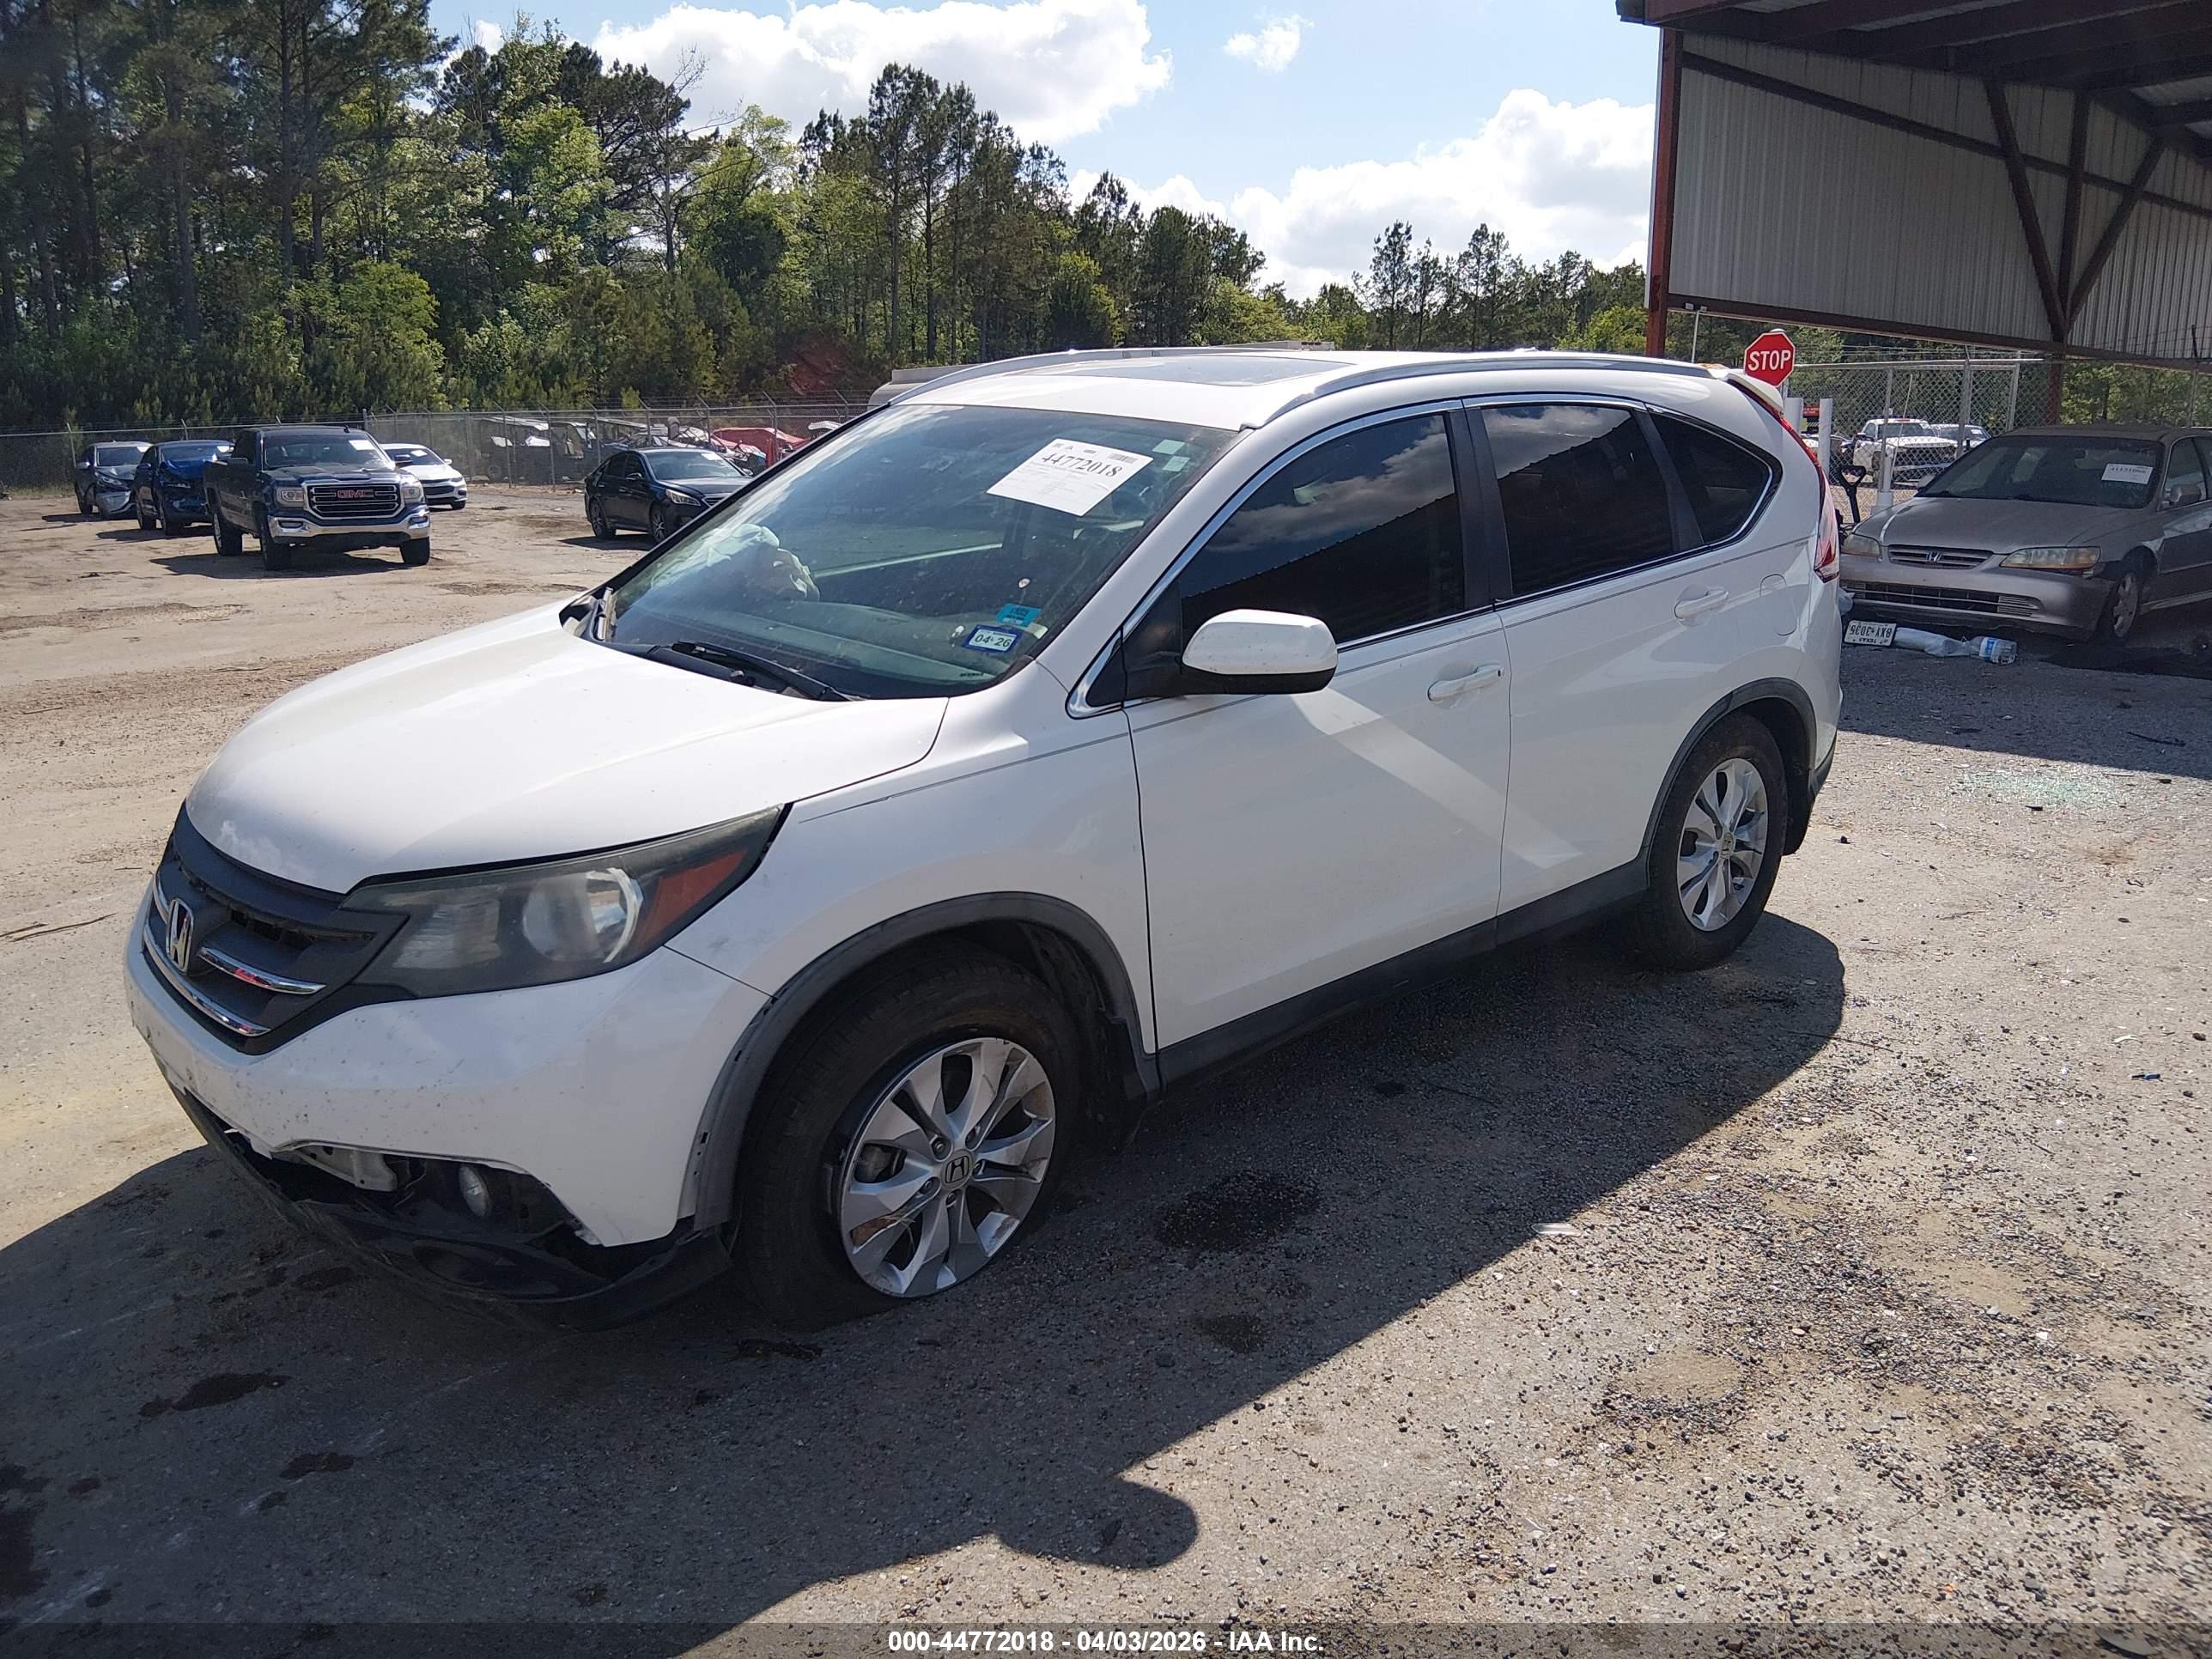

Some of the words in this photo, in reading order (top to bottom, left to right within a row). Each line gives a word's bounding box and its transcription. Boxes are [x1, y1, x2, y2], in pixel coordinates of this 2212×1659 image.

[1747, 349, 1791, 372] STOP
[1042, 453, 1123, 477] 44772018
[337, 489, 374, 499] GMC
